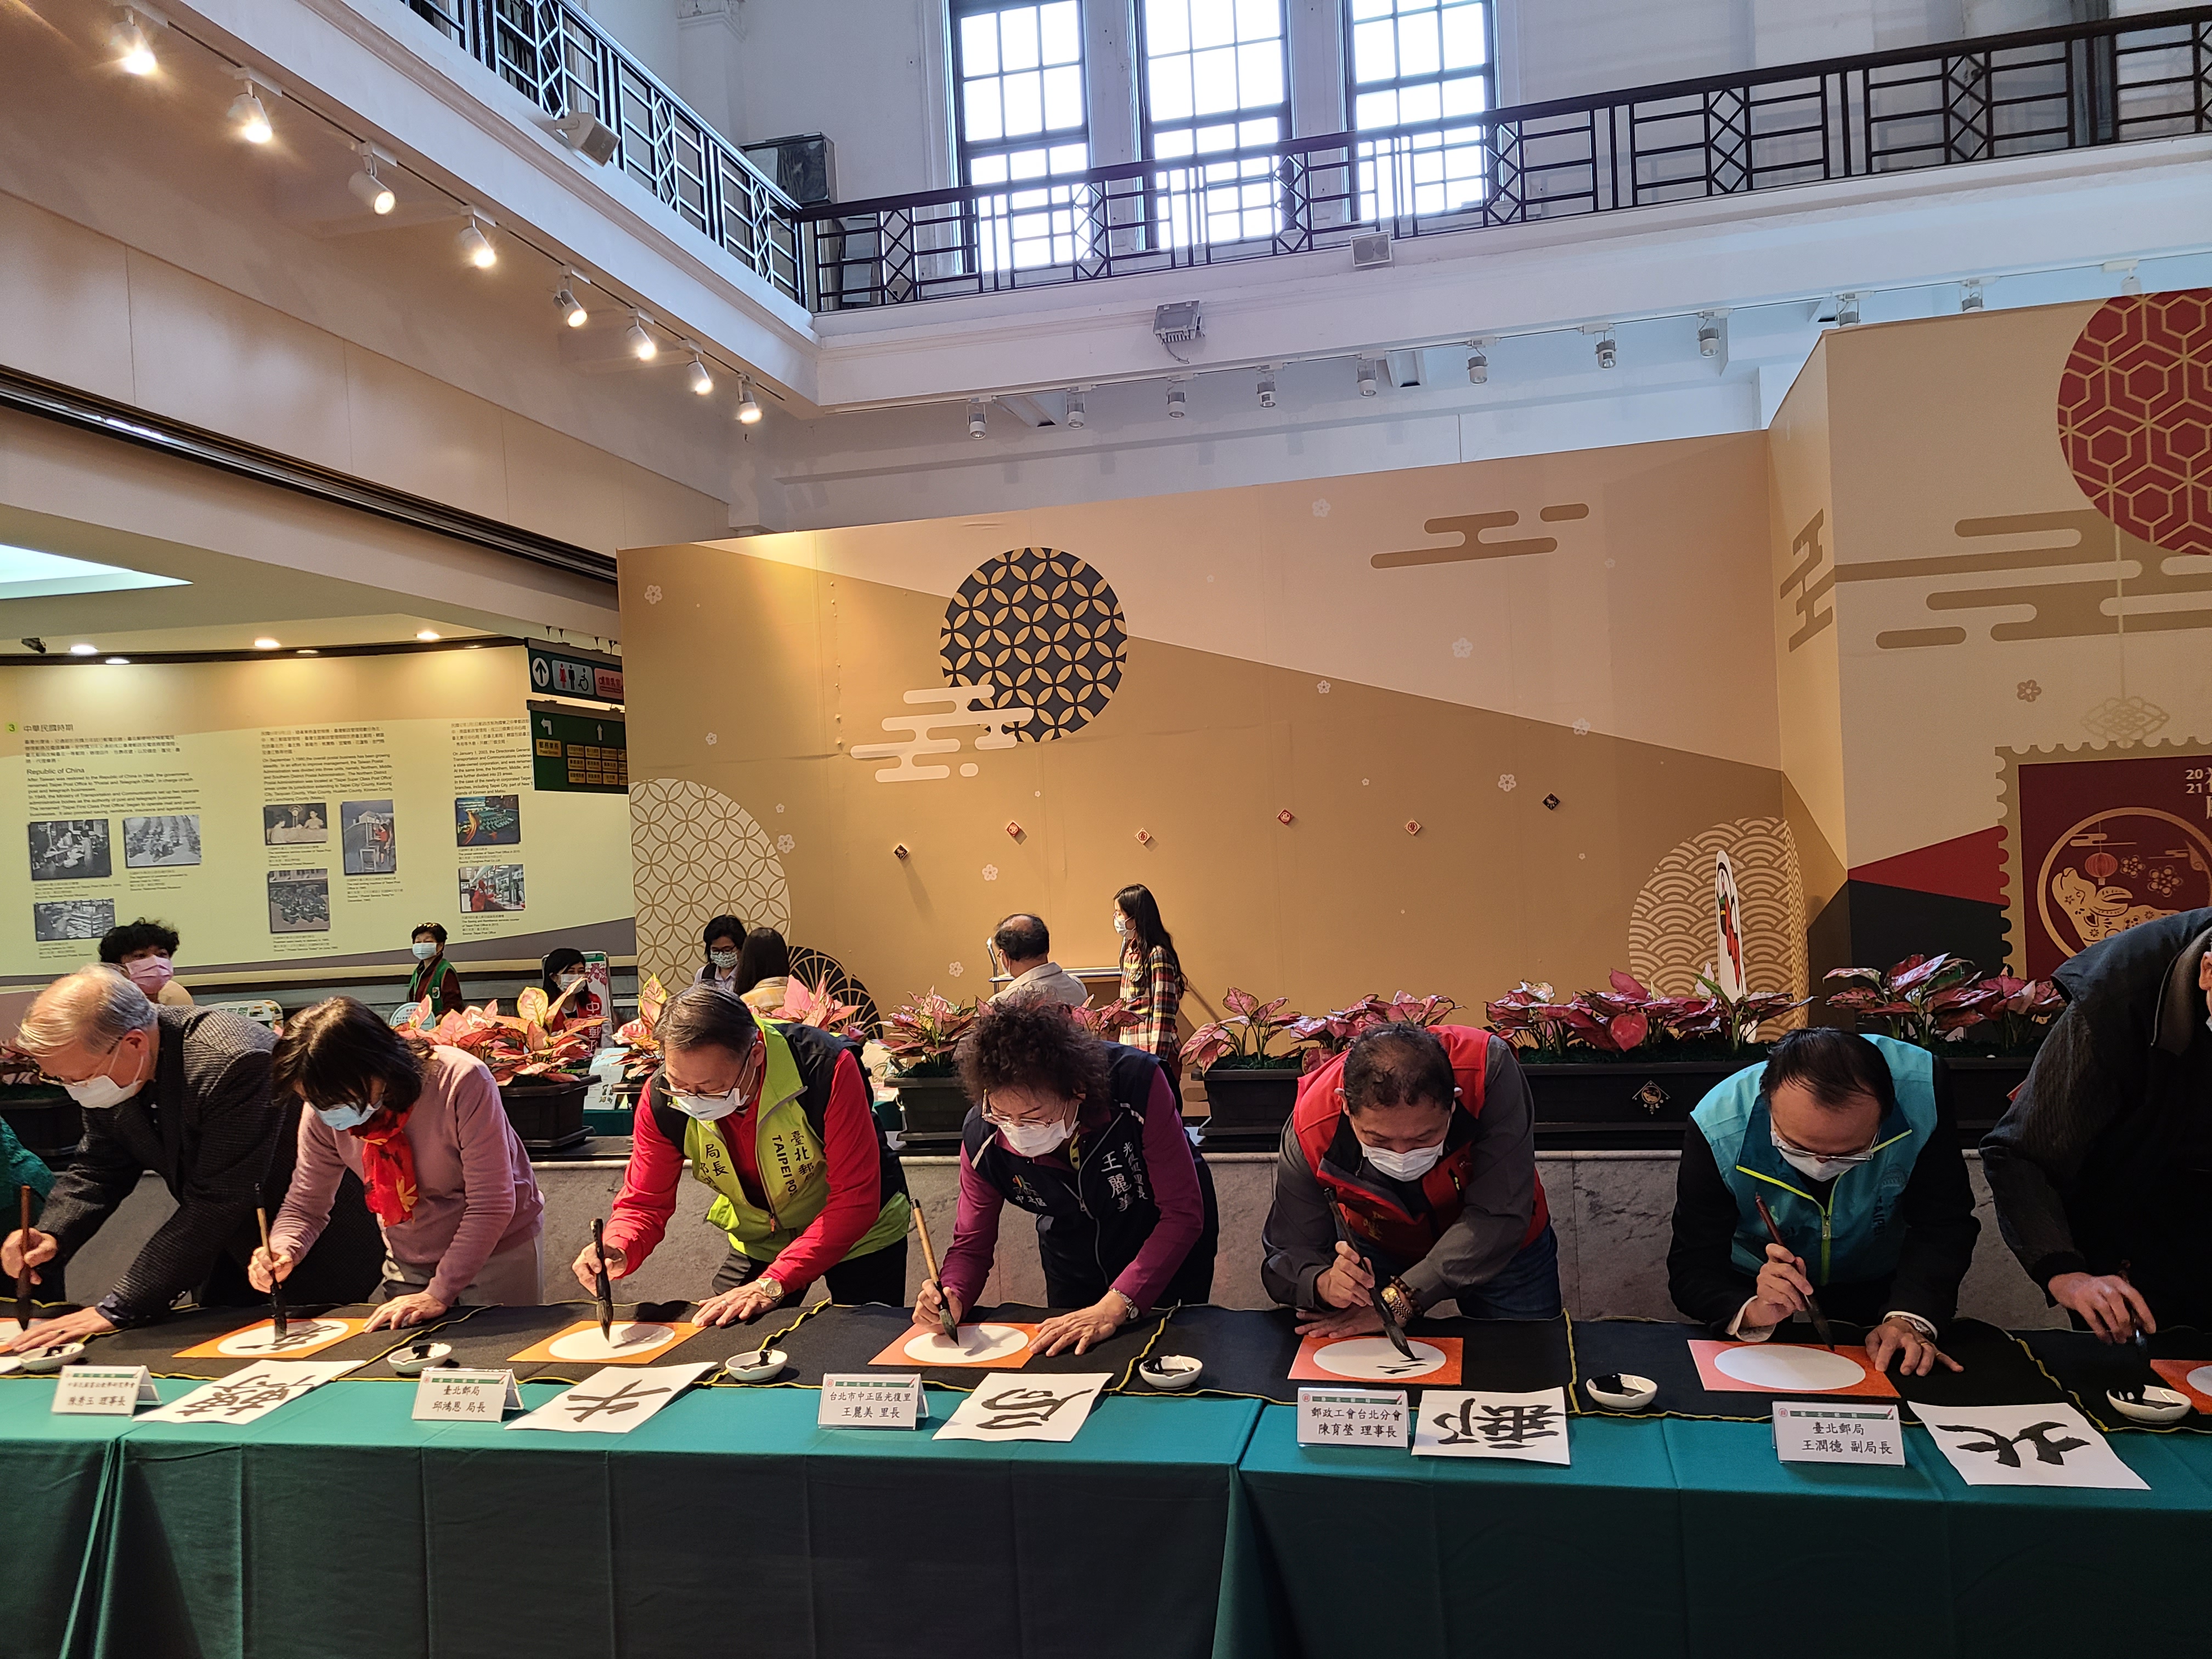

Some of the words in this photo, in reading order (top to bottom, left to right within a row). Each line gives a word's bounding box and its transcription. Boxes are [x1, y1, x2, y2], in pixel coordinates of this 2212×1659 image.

[24, 724, 74, 732] 中華民國時期
[2185, 769, 2204, 780] 20
[2186, 783, 2202, 793] 21
[706, 1144, 729, 1177] 局長
[772, 1135, 792, 1178] TAIPEI
[443, 1385, 480, 1396] 臺北郵局
[830, 1392, 911, 1402] 台北市中正區光復里
[99, 1396, 126, 1407] 理事長
[432, 1401, 461, 1413] 邱鴻恩
[466, 1402, 486, 1413] 局長
[564, 1379, 672, 1422] 牛
[842, 1406, 873, 1418] 王麗美
[879, 1407, 900, 1418] 里長
[975, 1388, 1094, 1430] 局
[1311, 1407, 1402, 1421] 郵政工會台北分會
[1318, 1423, 1354, 1436] 陳育瑩
[1360, 1424, 1397, 1437] 理事長
[1432, 1397, 1565, 1449] 郵
[1813, 1421, 1864, 1435] 臺北郵局
[1802, 1440, 1843, 1453] 王潤德
[1850, 1440, 1893, 1455] 副局長
[1935, 1421, 2091, 1468] 北
